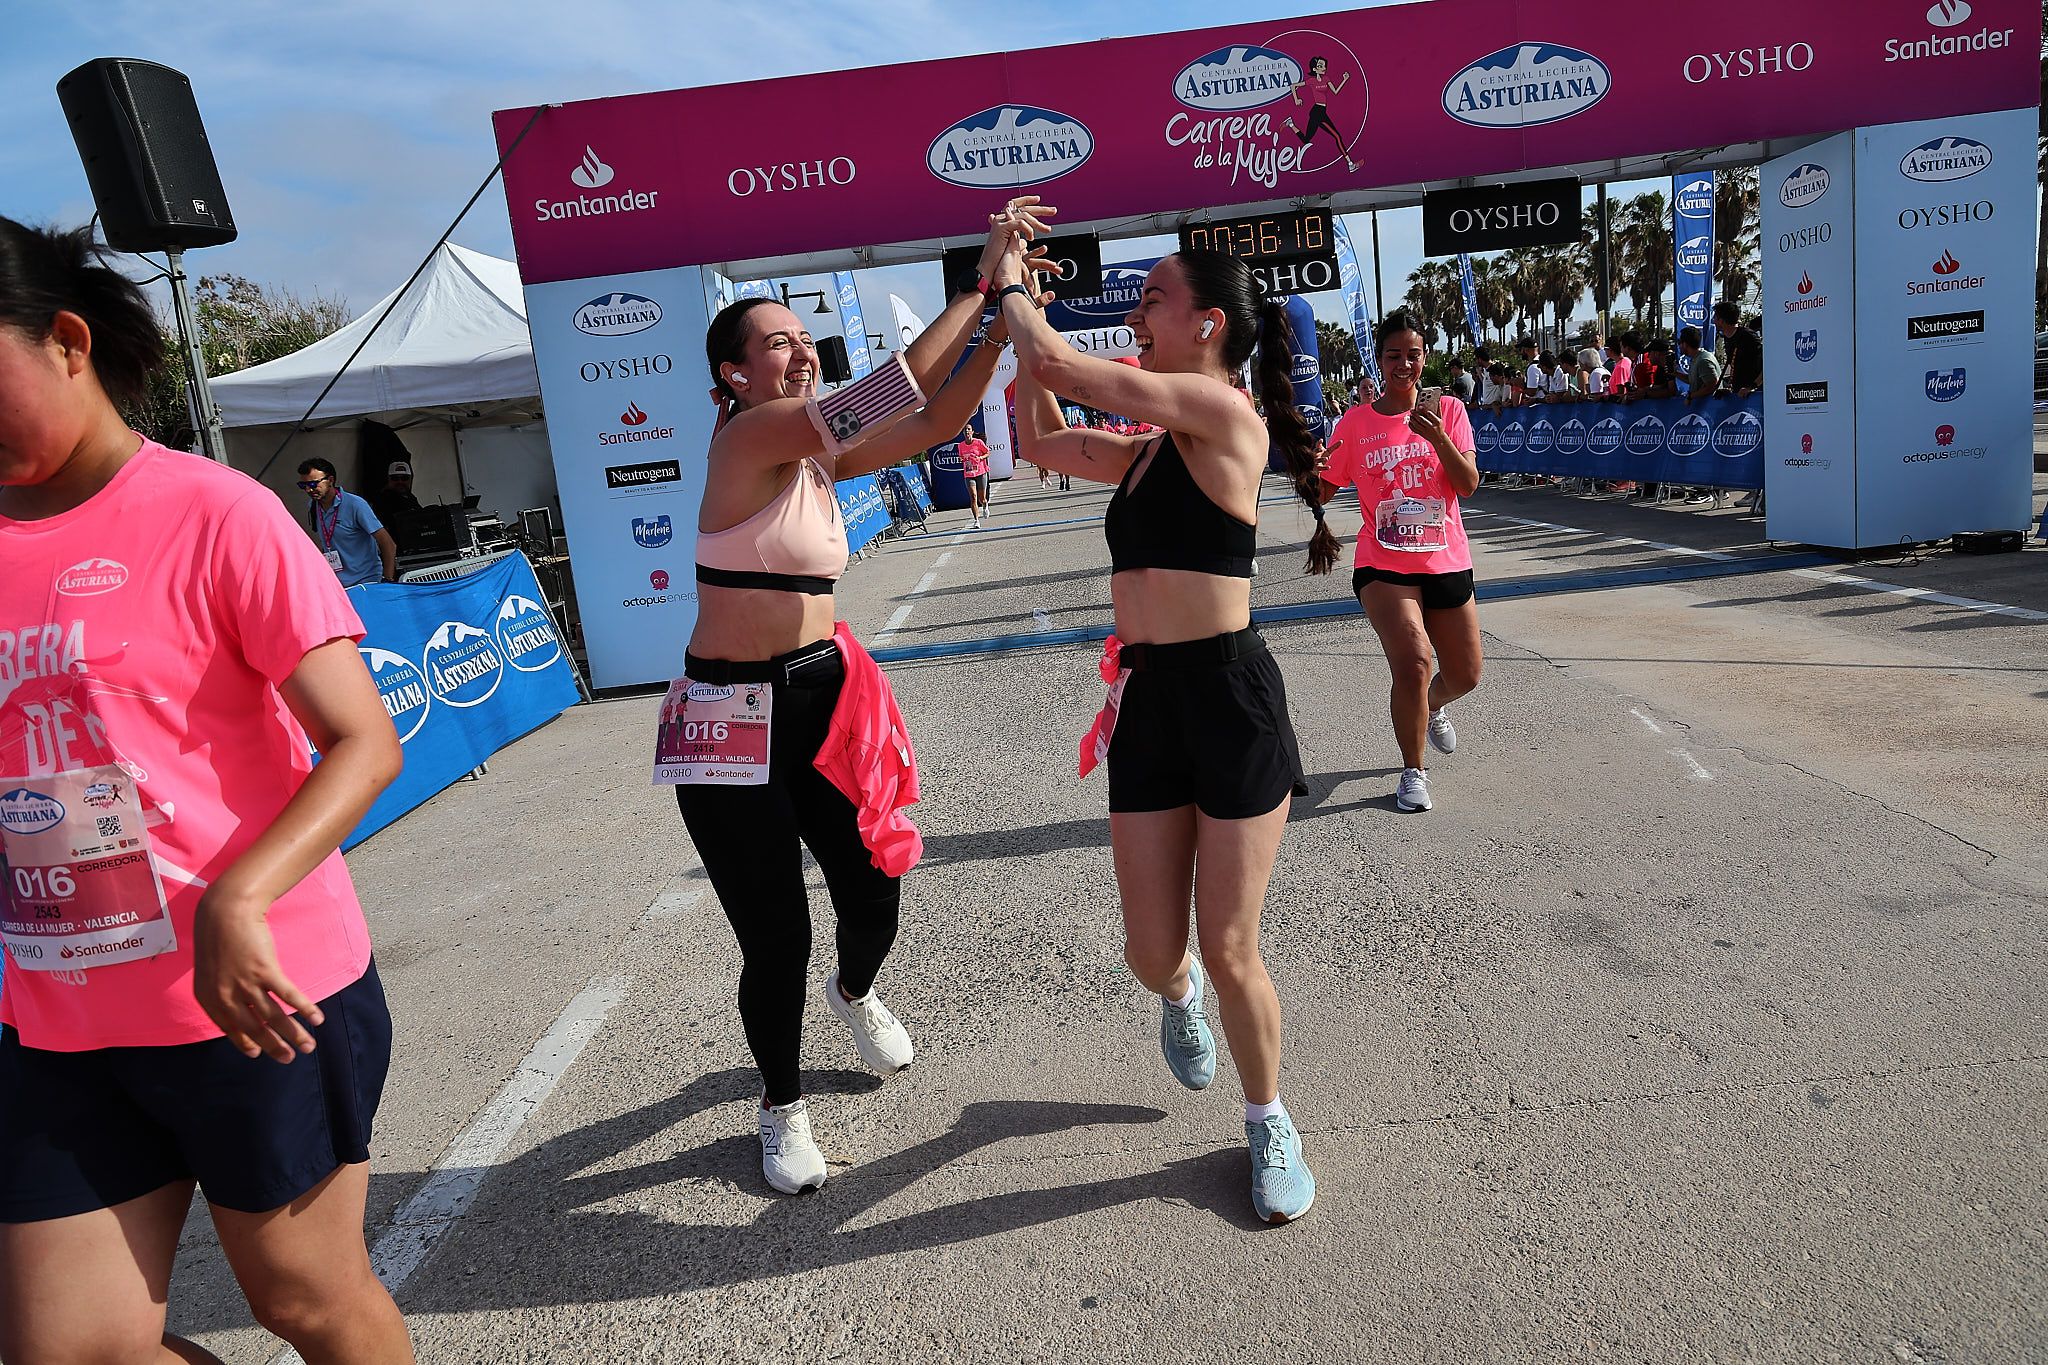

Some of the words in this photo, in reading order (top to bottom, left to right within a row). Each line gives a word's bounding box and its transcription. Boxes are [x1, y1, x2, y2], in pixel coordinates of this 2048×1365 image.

[1884, 27, 2014, 62] Santander
[1201, 68, 1243, 78] CENTRAL
[1246, 62, 1288, 73] LECHERA
[1683, 42, 1814, 84] OYSHO
[1480, 71, 1534, 85] CENTRAL
[1538, 64, 1592, 78] LECHERA
[1183, 71, 1294, 99] ASTURIANA
[1455, 76, 1599, 113] ASTURIANA
[963, 133, 1016, 146] CENTRAL
[1021, 127, 1075, 140] LECHERA
[1165, 112, 1272, 147] Carrera
[941, 138, 1082, 173] ASTURIANA
[1193, 145, 1214, 169] de
[1218, 142, 1232, 167] la
[1230, 132, 1313, 189] Mujer
[1952, 147, 1983, 156] LECHERA
[1906, 154, 1986, 174] ASTURIANA
[727, 156, 857, 197] OYSHO
[1783, 178, 1826, 202] ASTURIANA
[535, 189, 658, 221] Santander
[1898, 200, 1994, 229] OYSHO
[1450, 202, 1560, 233] OYSHO
[1779, 222, 1832, 253] OYSHO
[1252, 260, 1332, 295] SHO
[1906, 275, 1985, 295] Santander
[1784, 294, 1828, 314] Santander
[580, 309, 657, 329] ASTURIANA
[1913, 318, 1980, 334] Neutrogena
[1068, 328, 1133, 353] SHO
[580, 354, 672, 382] OYSHO
[1788, 387, 1825, 401] Neutrogena
[1928, 376, 1964, 395] Marlene
[598, 427, 674, 446] Santander
[1359, 432, 1387, 445] OYSHO
[1714, 429, 1757, 446] ASTURIANA
[1365, 441, 1431, 469] CARRERA
[611, 467, 676, 483] Neutrogena
[1402, 463, 1424, 490] DE
[635, 523, 670, 541] Marlene
[1398, 524, 1425, 536] 016
[60, 573, 122, 590] ASTURIANA
[0, 619, 88, 681] RERA
[503, 623, 555, 660] ASTURIAN
[383, 669, 413, 687] LECHERA
[381, 681, 426, 718] RIANA
[689, 687, 731, 696] ASTURIANA
[684, 721, 729, 741] 016
[661, 755, 683, 763] CARRERA
[699, 754, 720, 762] MUJER
[725, 755, 755, 763] VALENCIA
[661, 768, 692, 778] OYSHO
[715, 769, 755, 779] Santander
[0, 805, 58, 823] ASTURIANA
[77, 854, 145, 873] CORREDORA
[15, 866, 76, 898] 016
[2, 920, 25, 933] CARRERA
[26, 923, 35, 933] DE
[35, 923, 45, 933] LA
[45, 922, 75, 933] MUJER
[84, 910, 140, 929] VALENCIA
[34, 905, 62, 919] 2543
[9, 942, 43, 959] OYSHO
[75, 937, 144, 958] Santander
